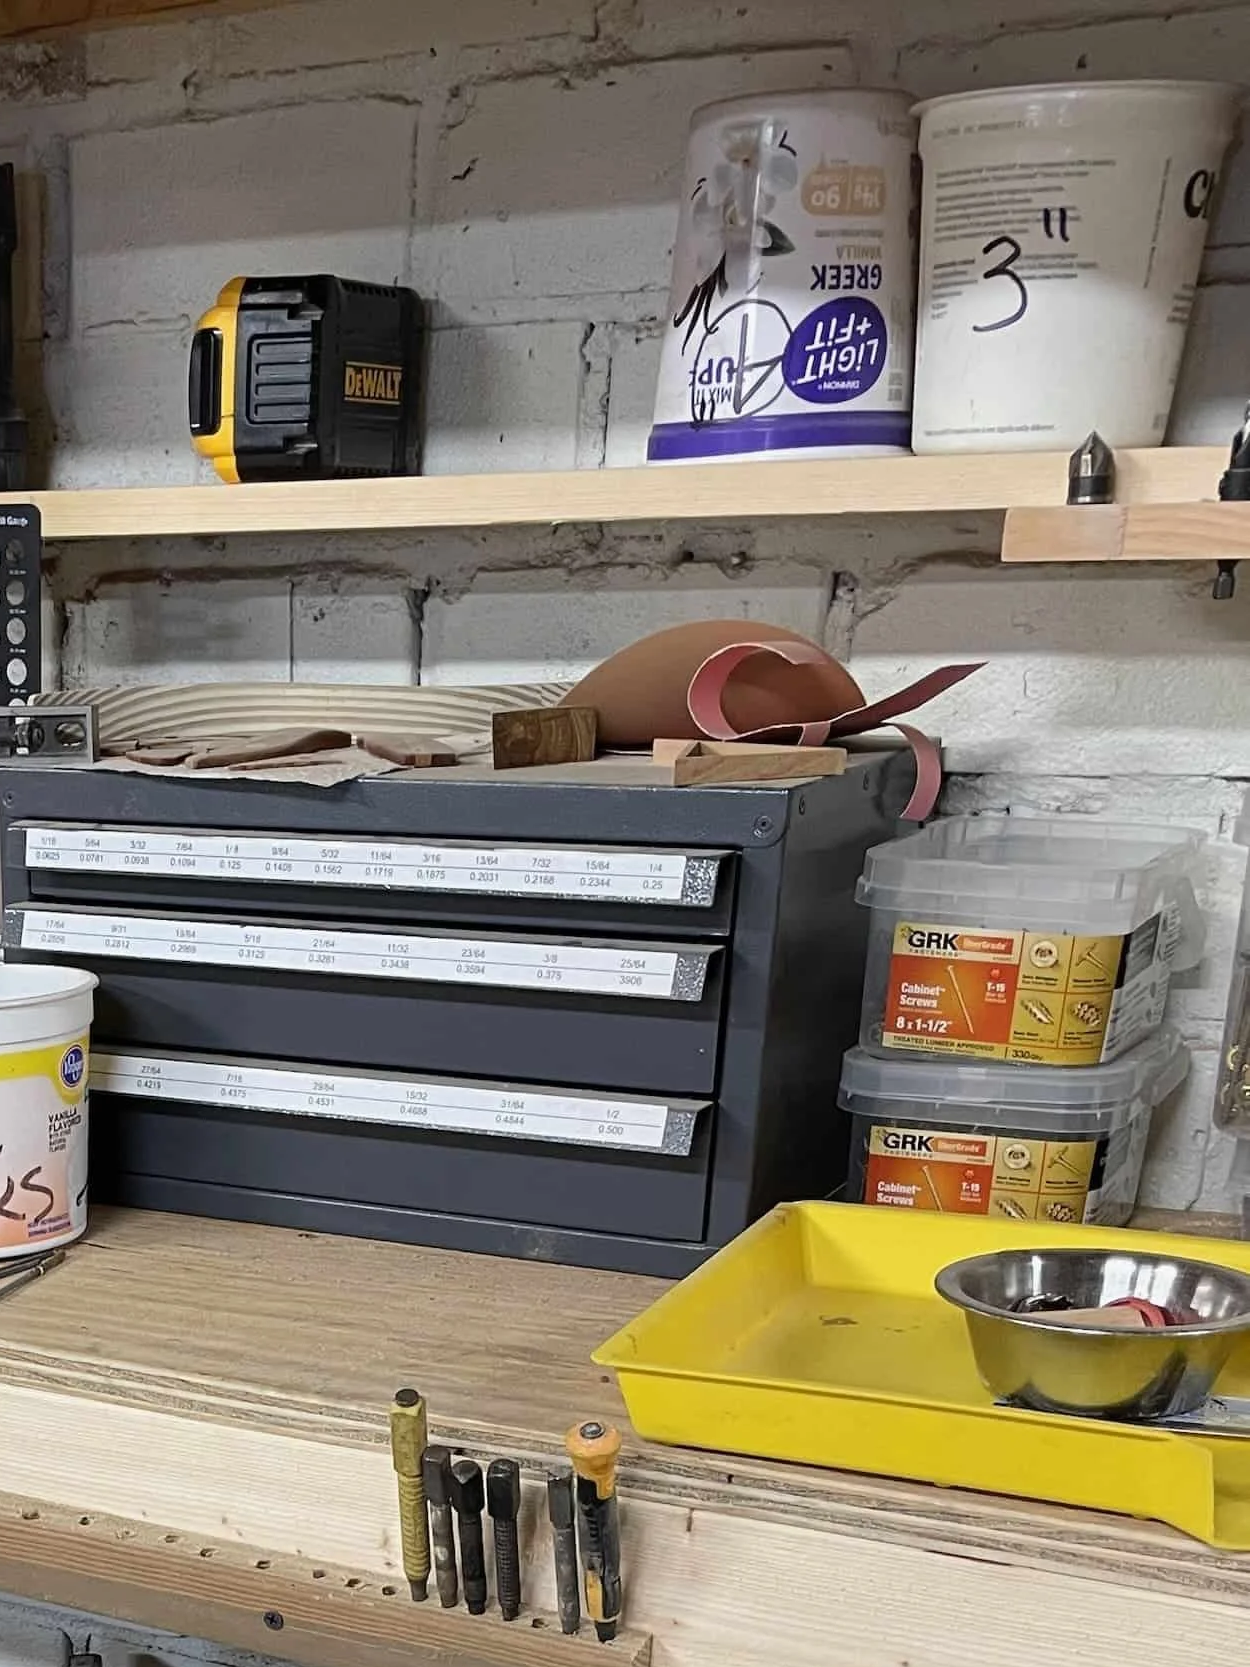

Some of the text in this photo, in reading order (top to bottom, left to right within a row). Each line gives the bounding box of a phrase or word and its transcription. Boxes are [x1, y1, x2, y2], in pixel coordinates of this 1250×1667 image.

[810, 264, 883, 290] GREEK
[649, 863, 662, 873] 1/4
[642, 880, 663, 890] 0.25
[908, 930, 959, 951] GRK
[901, 982, 941, 996] Cabinet
[899, 994, 938, 1009] Screws
[896, 1016, 905, 1029] 8
[606, 1108, 620, 1119] 1/2
[883, 1132, 934, 1152] GRK
[877, 1181, 916, 1195] Cabinet
[876, 1192, 914, 1206] Screws
